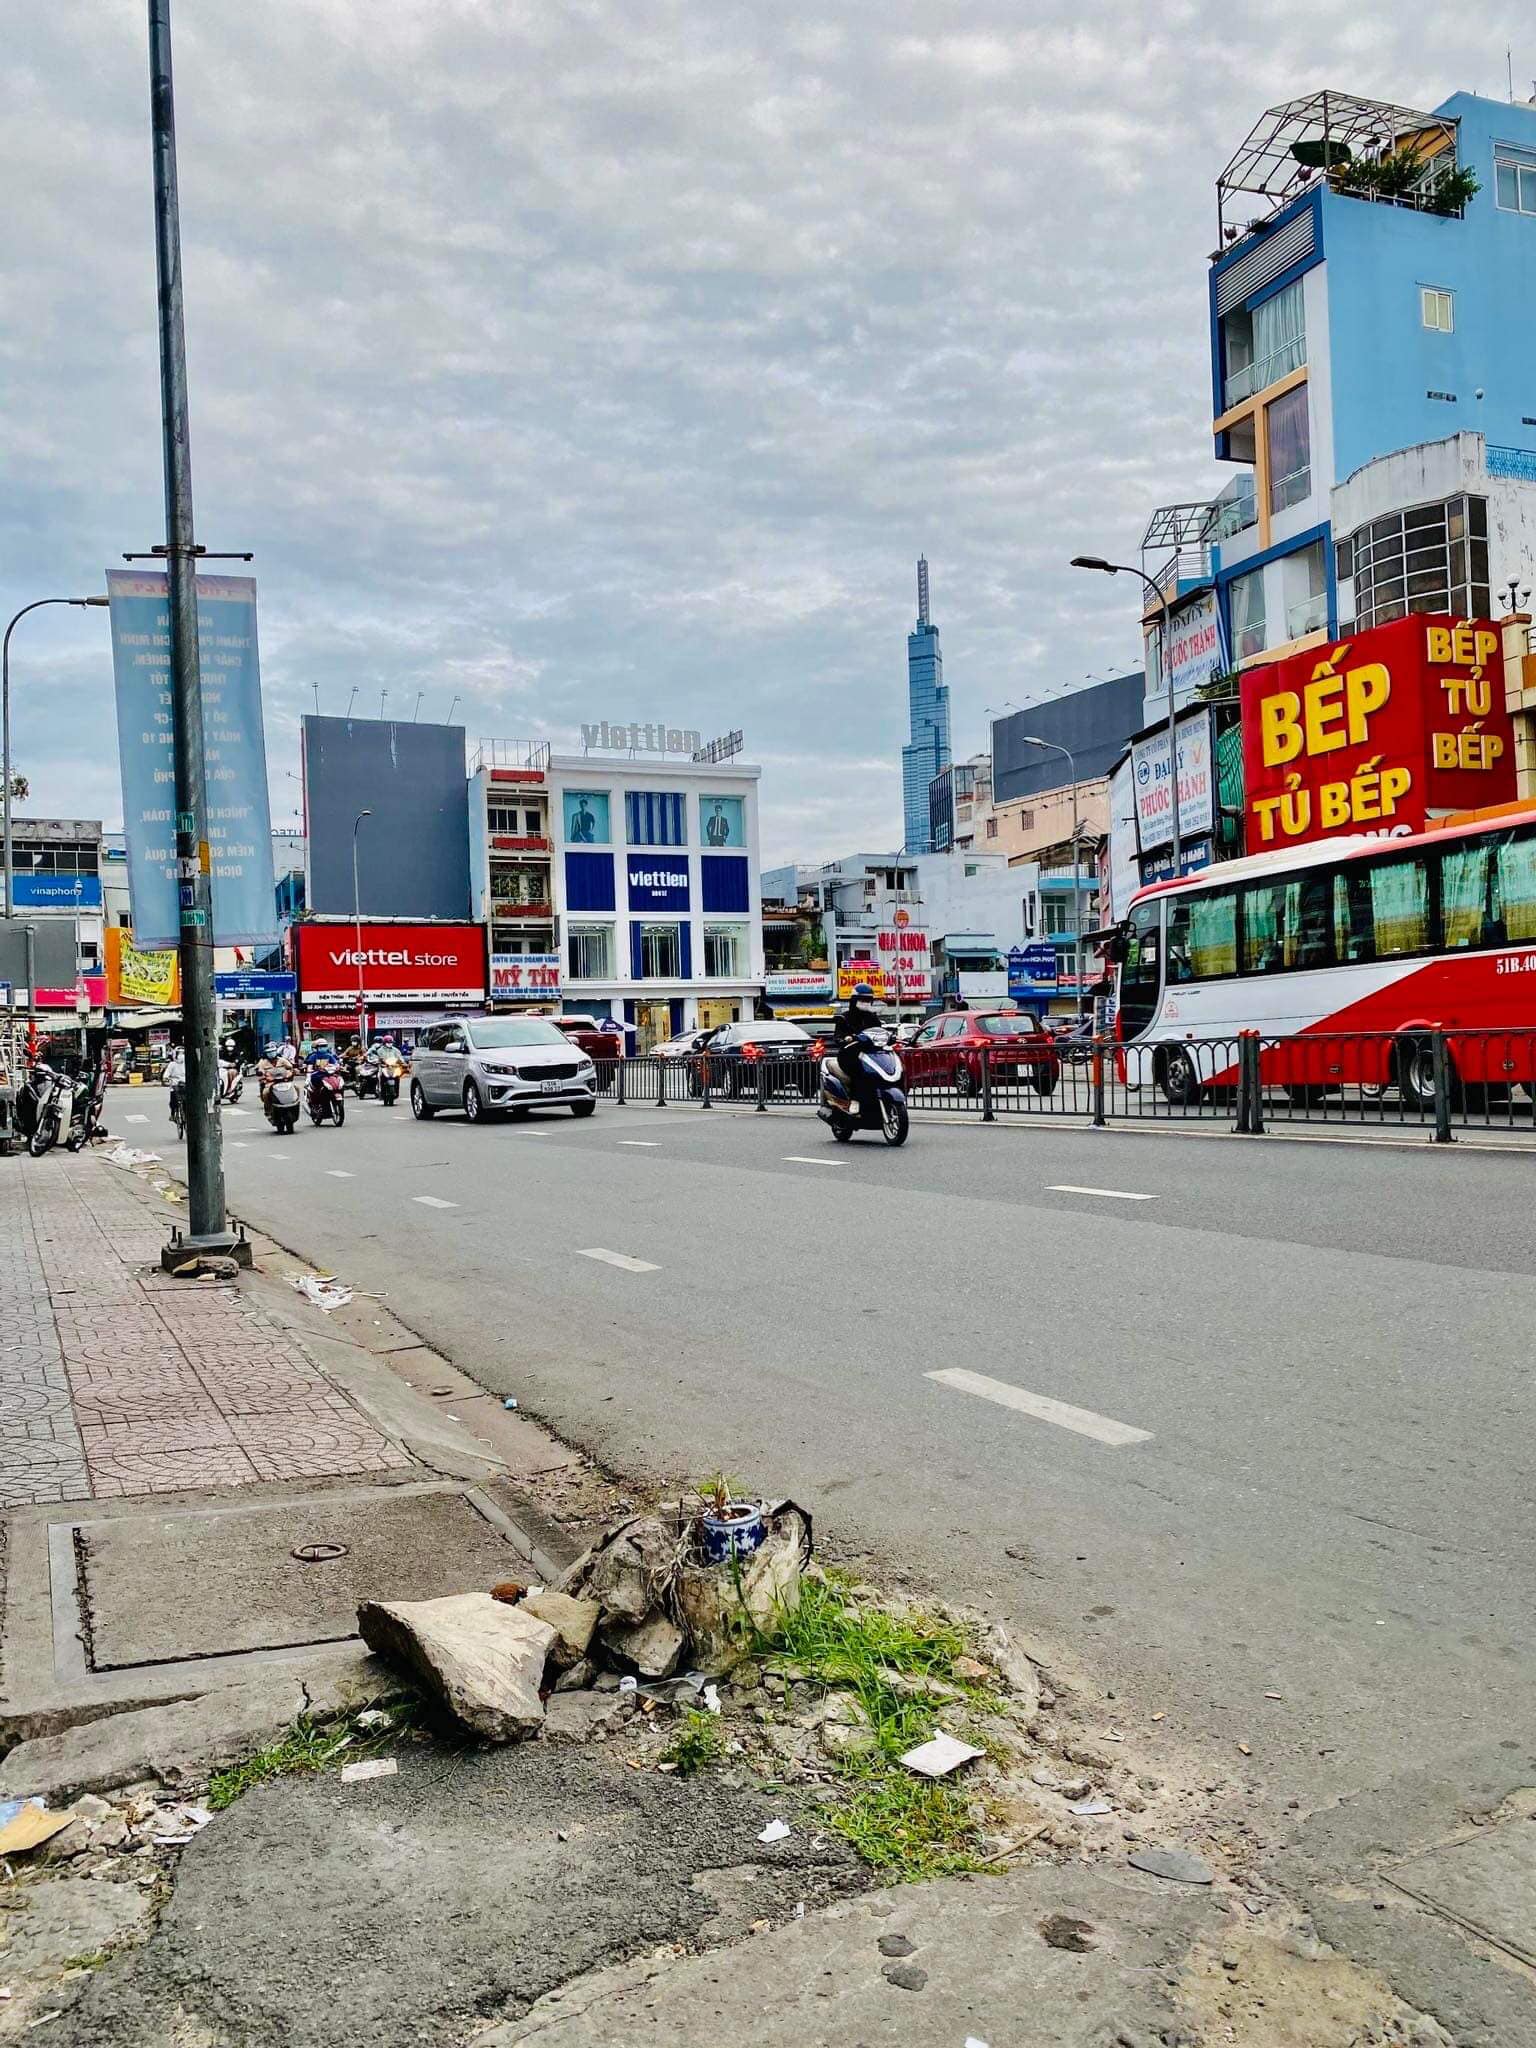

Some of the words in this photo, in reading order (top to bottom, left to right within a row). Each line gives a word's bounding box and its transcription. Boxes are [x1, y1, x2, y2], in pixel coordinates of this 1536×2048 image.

[1426, 617, 1498, 666] BẾP
[1260, 644, 1391, 768] BẾP
[1440, 666, 1492, 716] TỦ
[581, 721, 701, 753] viettien
[1432, 721, 1504, 770] BẾP
[1140, 784, 1170, 818] PHƯỚC
[1176, 771, 1207, 804] HÀNH
[1252, 772, 1311, 840] TỦ
[1319, 754, 1412, 829] BẾP
[630, 871, 687, 887] viettien
[329, 949, 412, 966] viettel
[415, 954, 458, 966] store
[900, 933, 926, 951] KHOA
[493, 965, 523, 987] MỸ
[528, 964, 560, 987] TÍN
[892, 957, 914, 970] 294
